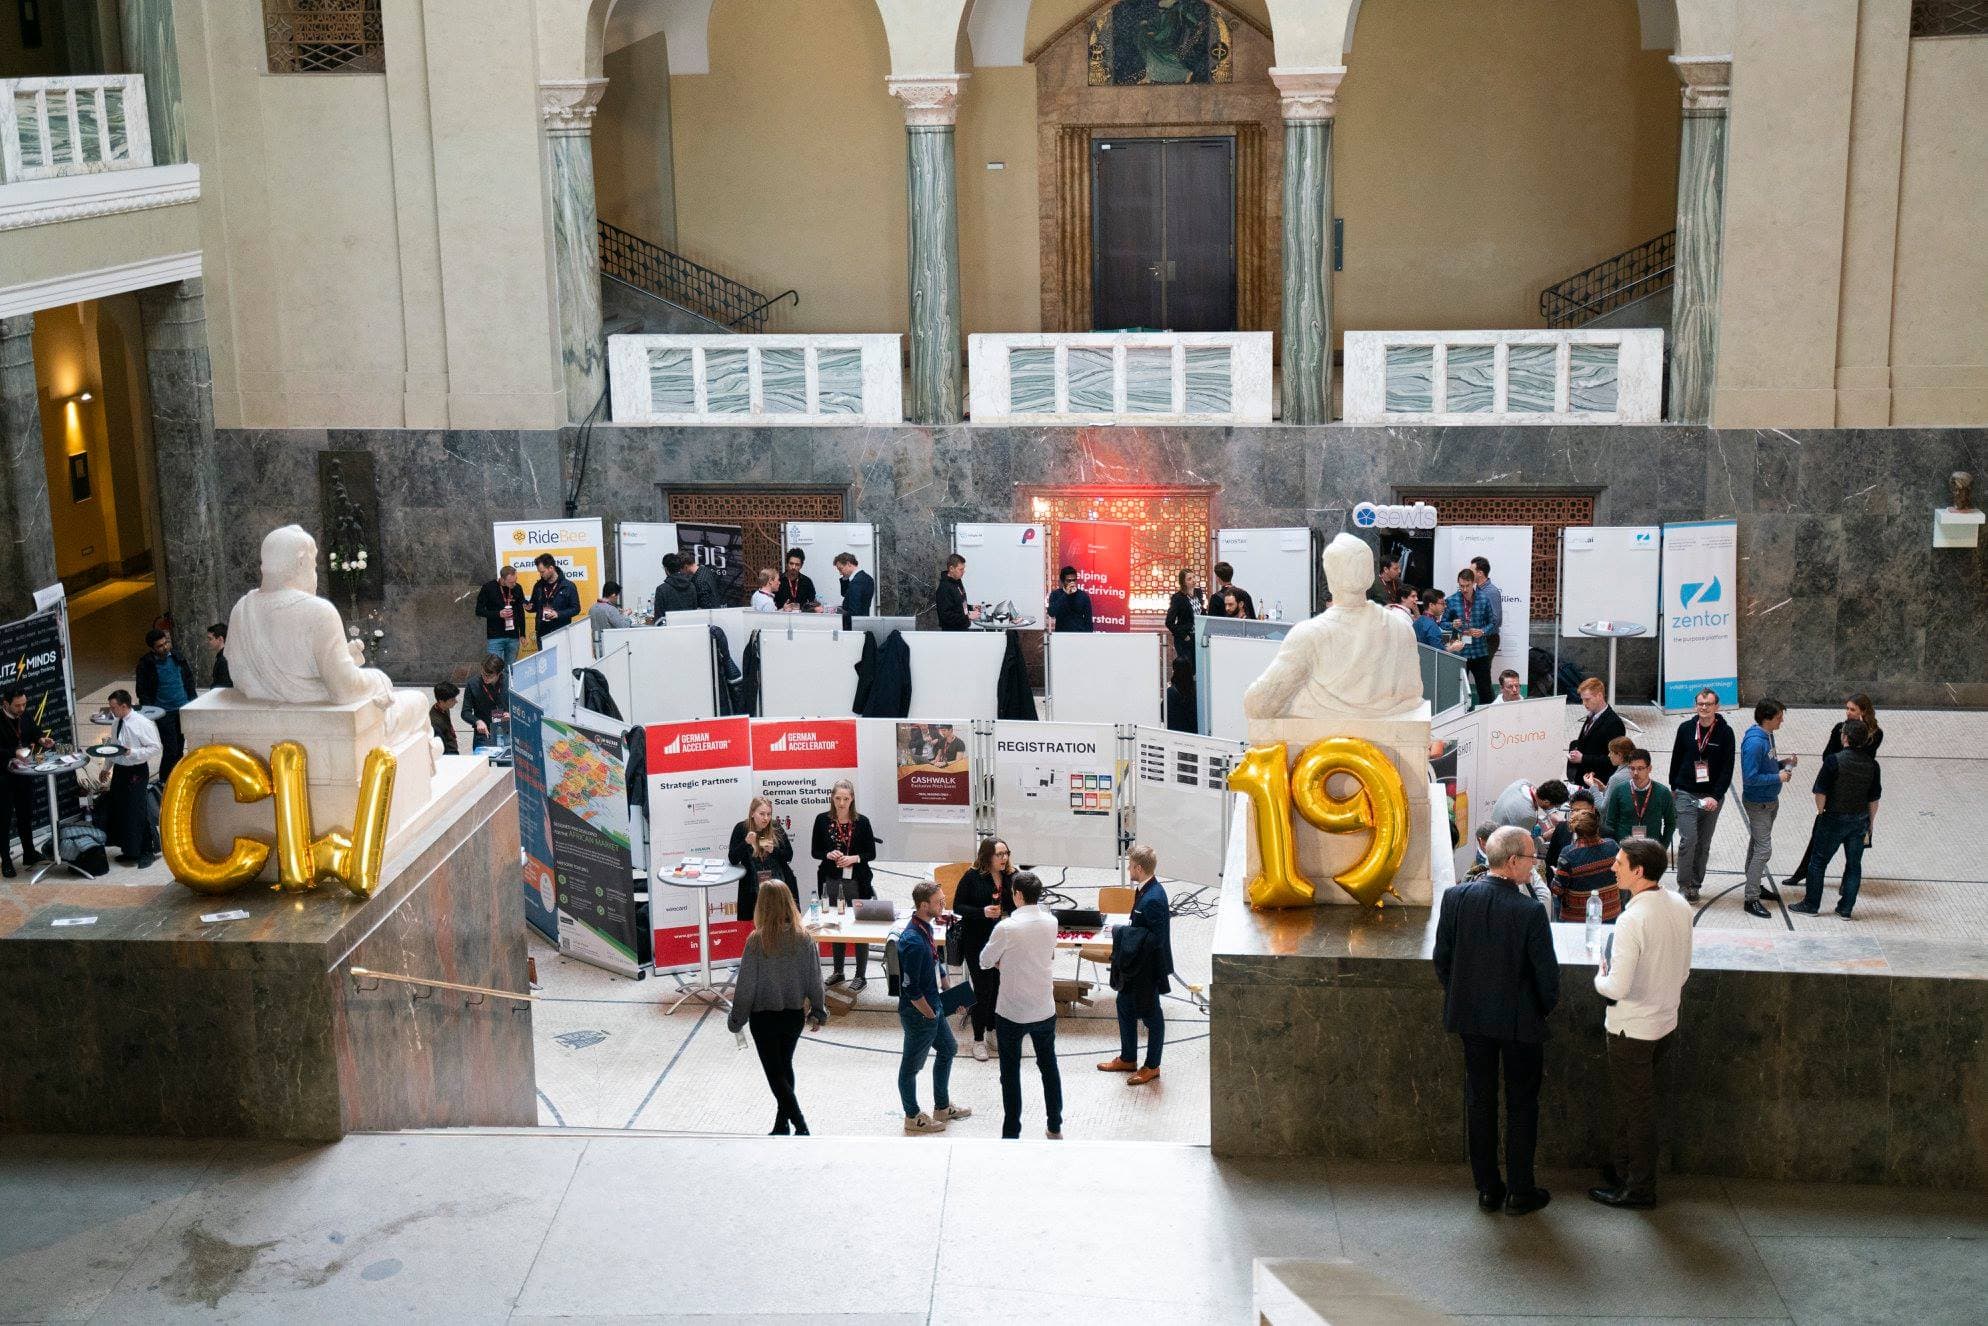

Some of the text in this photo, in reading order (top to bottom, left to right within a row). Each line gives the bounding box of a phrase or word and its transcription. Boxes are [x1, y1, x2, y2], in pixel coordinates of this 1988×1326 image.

[528, 529, 587, 544] RideBee
[1077, 570, 1107, 583] elping
[1077, 584, 1126, 599] lf-driving
[1092, 615, 1125, 625] rstand
[1672, 610, 1730, 628] zentor
[0, 651, 57, 679] ITZ MINDS
[681, 733, 710, 744] GERMAN
[787, 732, 817, 741] GERMAN
[997, 741, 1096, 753] REGISTRATION
[660, 777, 738, 790] Strategic Partners
[762, 778, 817, 787] Empowering
[910, 776, 956, 784] CASHWALK
[762, 788, 832, 797] German Startup
[801, 797, 832, 805] Globall
[160, 740, 397, 899] CW
[1227, 737, 1410, 908] 19
